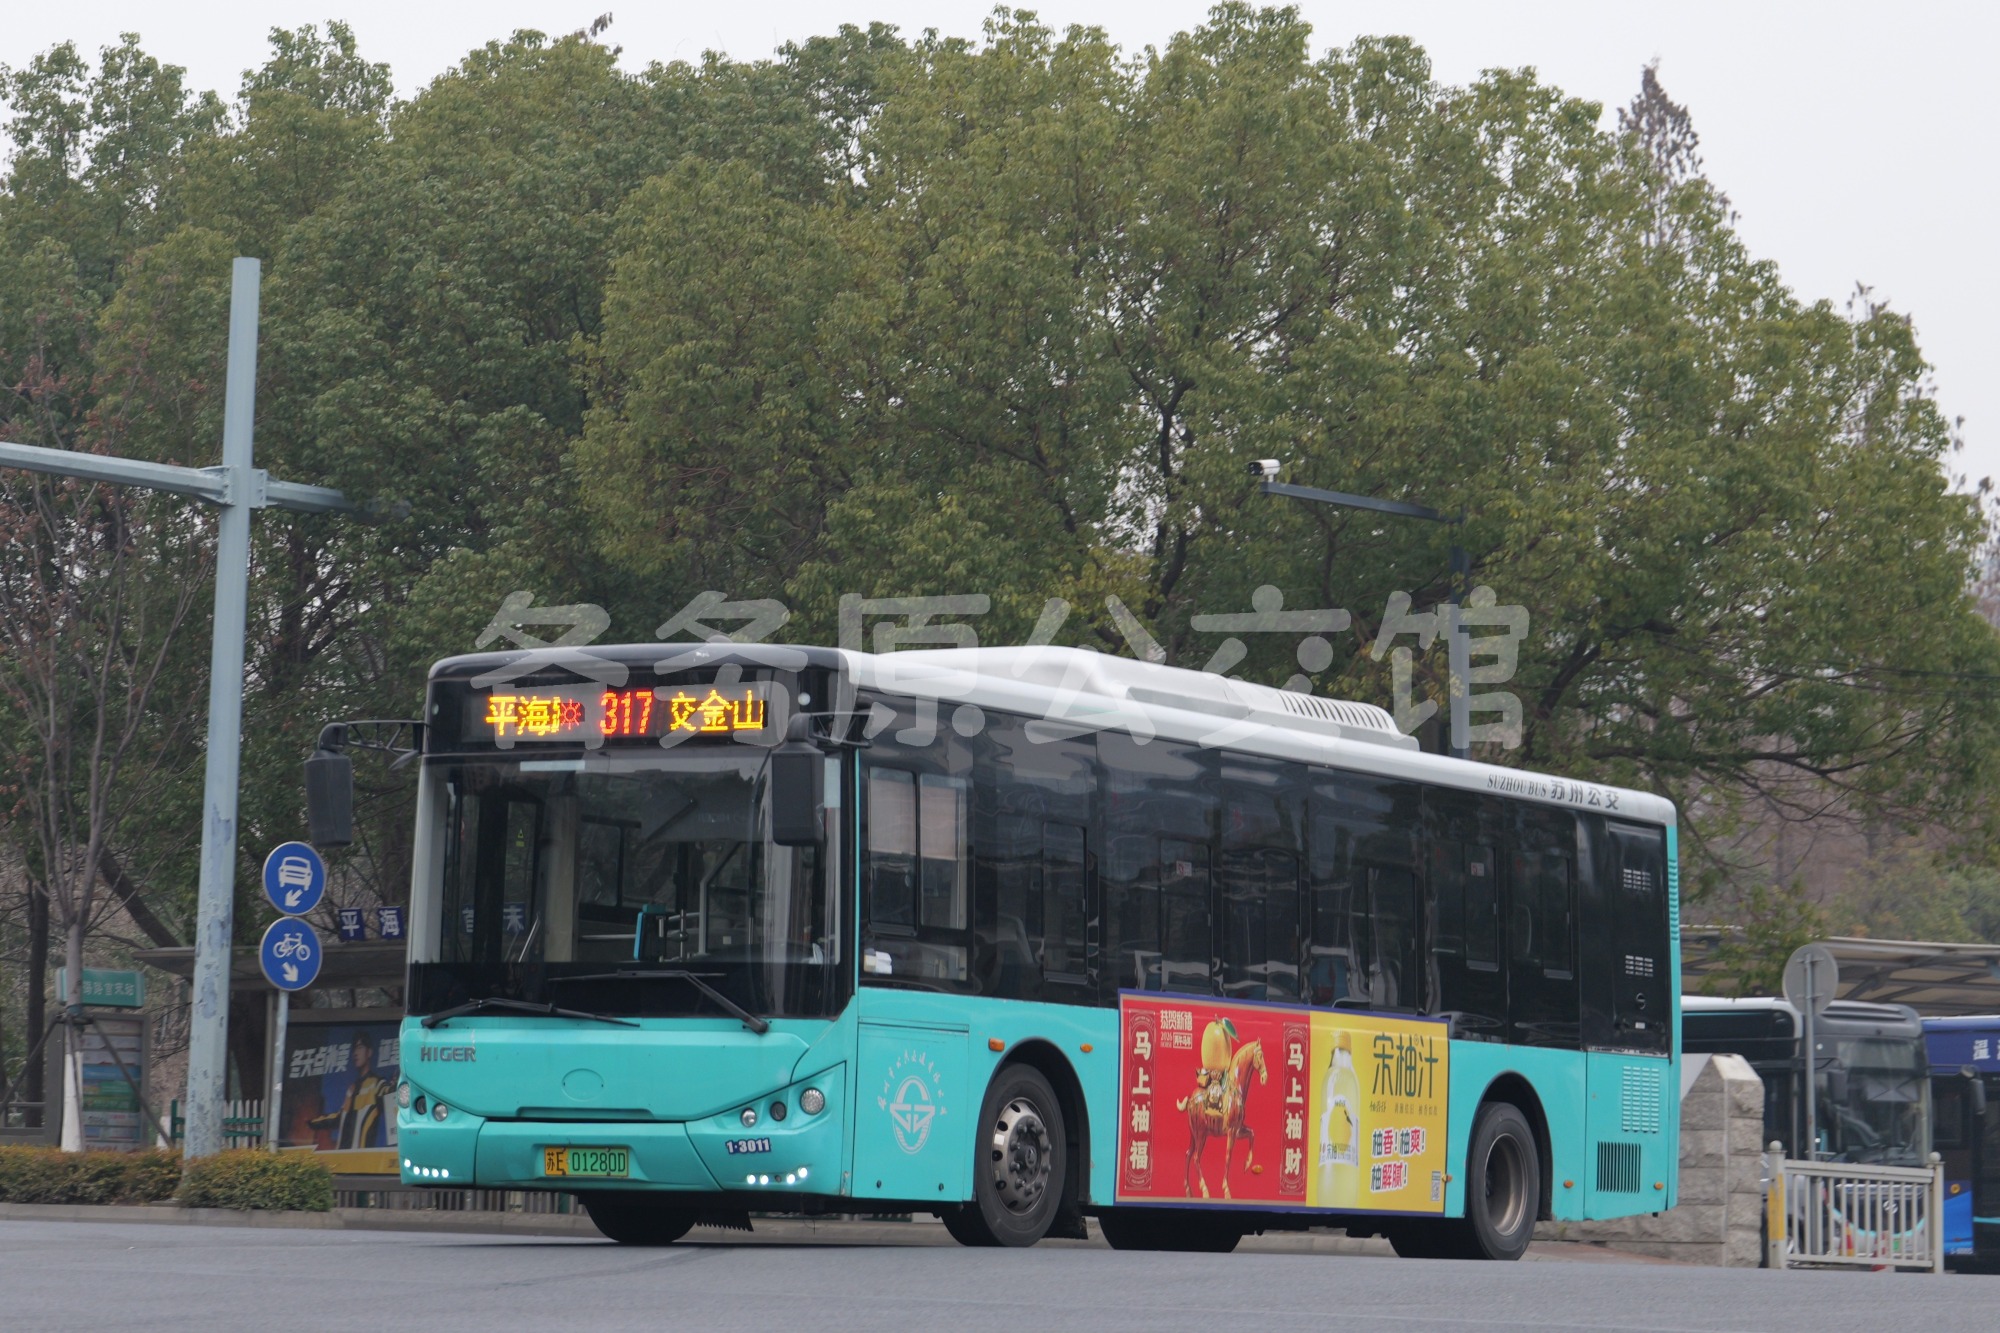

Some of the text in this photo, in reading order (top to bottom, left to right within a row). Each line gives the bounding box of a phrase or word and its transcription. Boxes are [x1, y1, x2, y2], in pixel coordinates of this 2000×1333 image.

[600, 691, 653, 734] 317
[671, 690, 764, 731] 交金山
[1487, 774, 1619, 810] SUZHOU BUS 苏州公交
[289, 1043, 352, 1078] 冬天点外卖
[420, 1046, 476, 1062] HIGER
